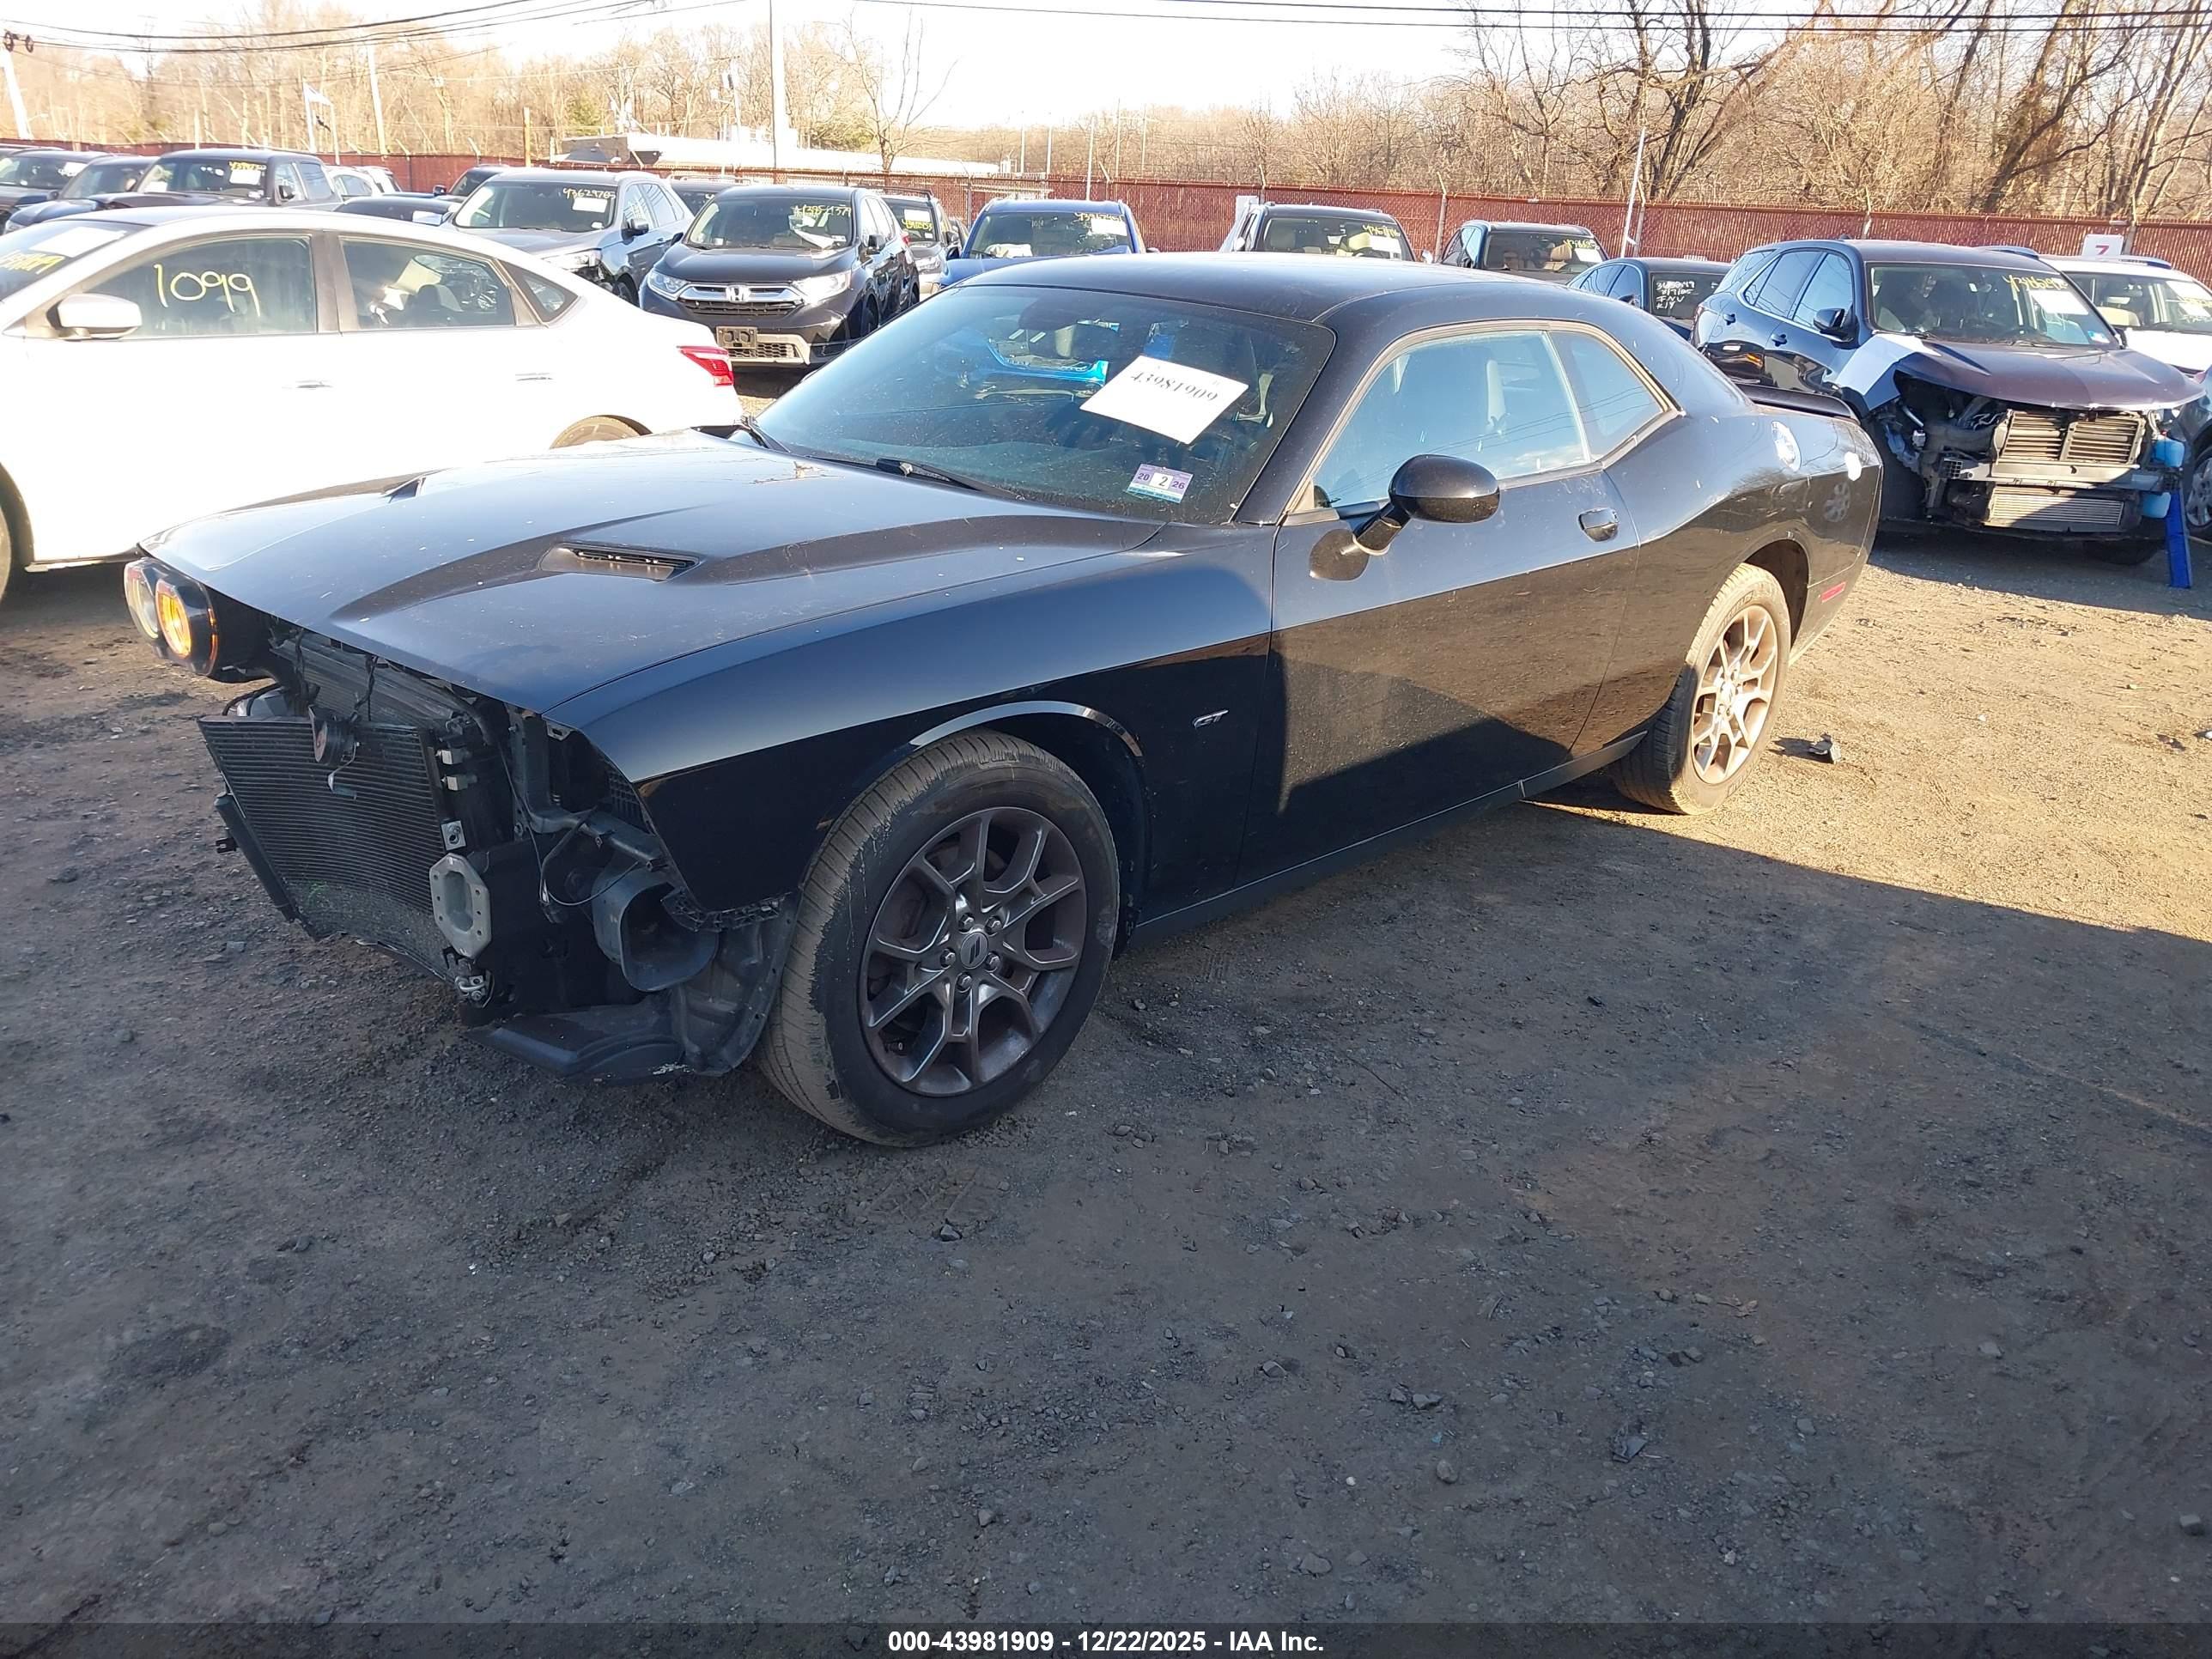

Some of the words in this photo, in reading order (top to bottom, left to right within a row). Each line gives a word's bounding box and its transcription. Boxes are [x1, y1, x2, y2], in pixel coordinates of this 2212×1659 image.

[154, 264, 261, 317] 1099
[1130, 371, 1218, 401] 43981909
[1137, 472, 1151, 482] 20
[1158, 476, 1169, 487] 2
[1171, 481, 1186, 489] 26
[1193, 709, 1229, 728] GT
